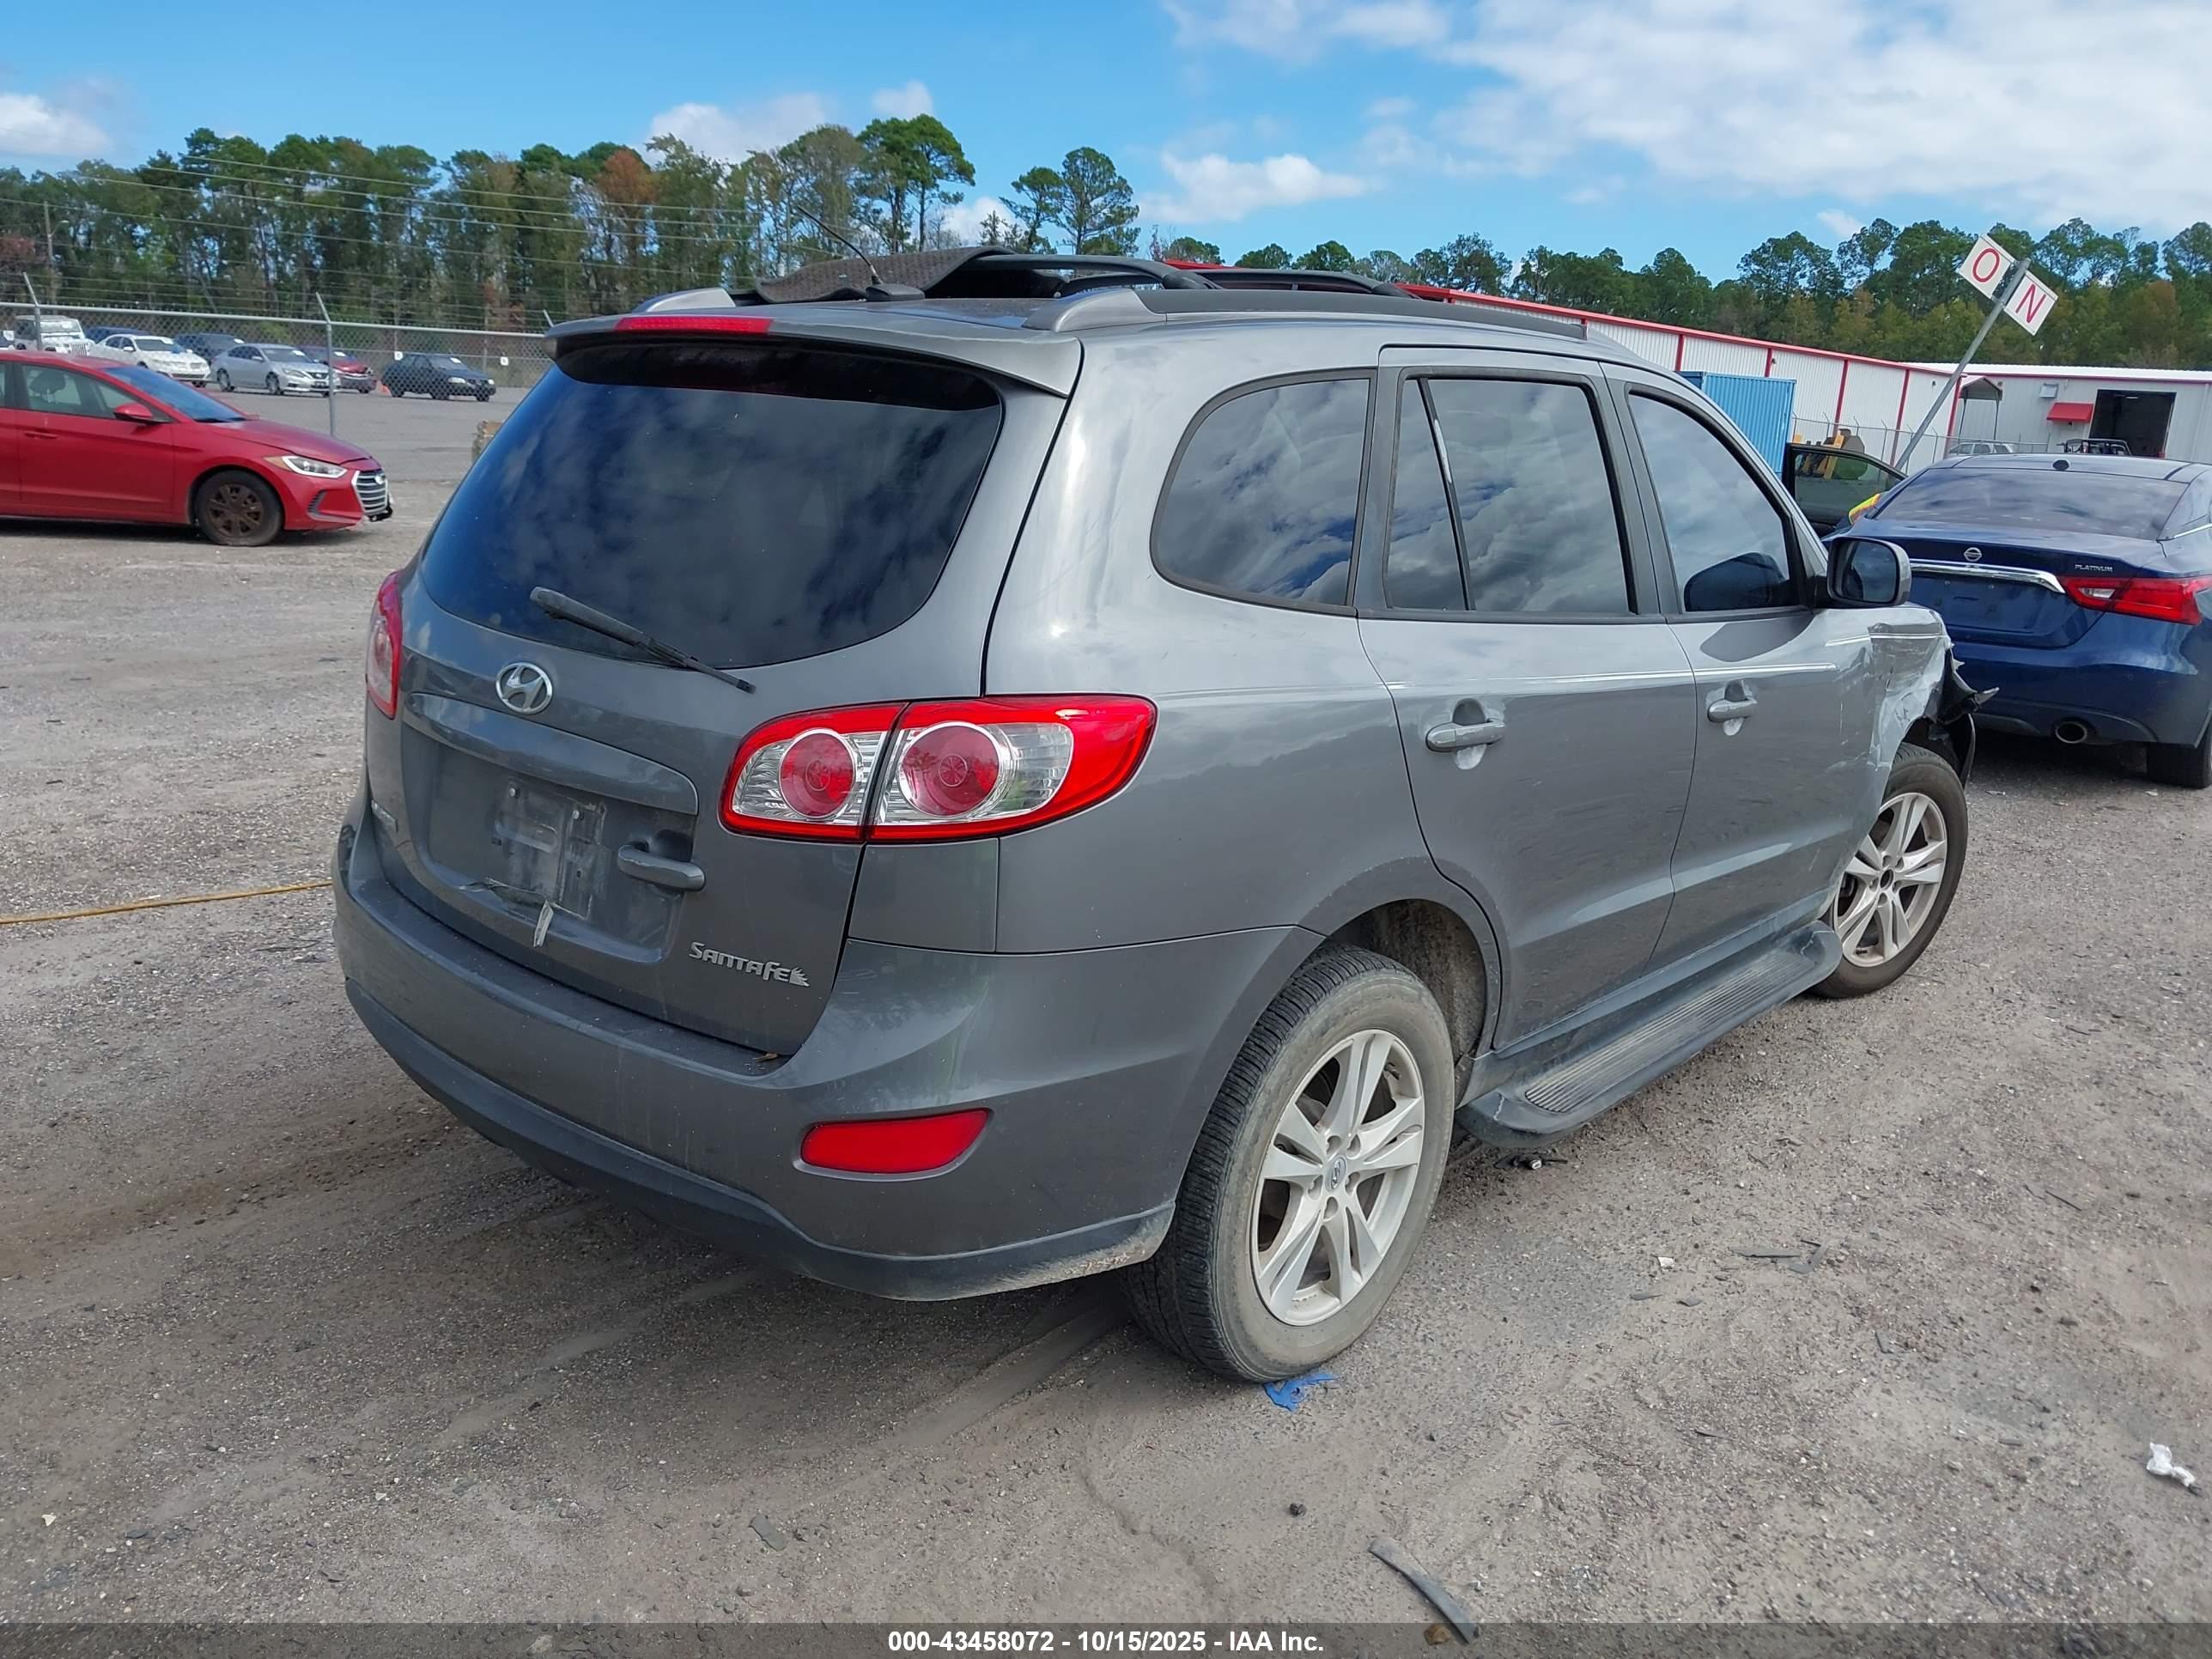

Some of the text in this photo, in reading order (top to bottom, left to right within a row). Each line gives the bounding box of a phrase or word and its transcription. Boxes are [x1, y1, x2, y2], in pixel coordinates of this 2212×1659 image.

[1972, 246, 2001, 283] O
[2014, 283, 2047, 324] N
[2074, 563, 2113, 573] PLATINUM
